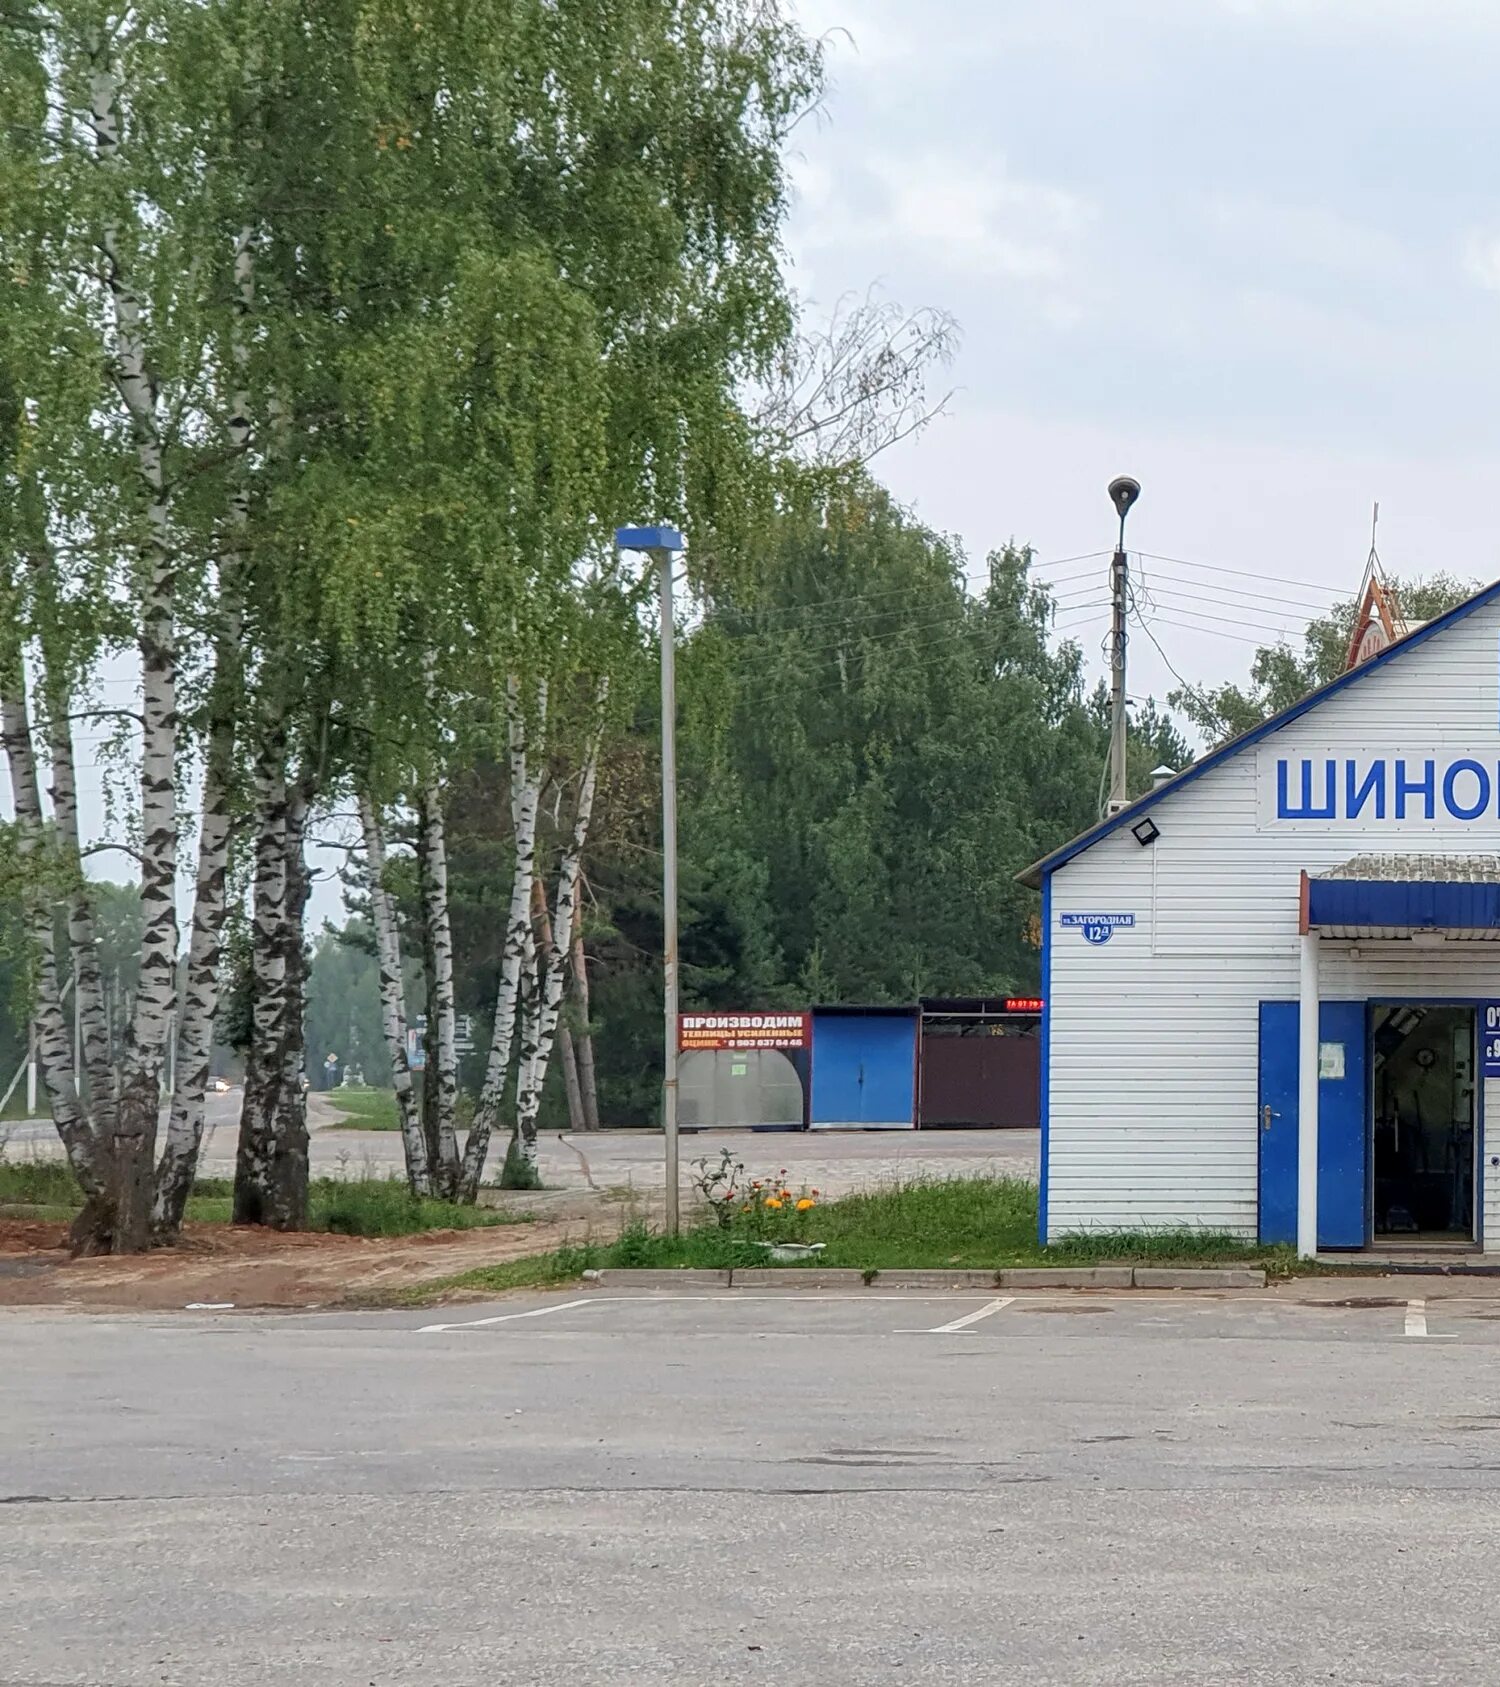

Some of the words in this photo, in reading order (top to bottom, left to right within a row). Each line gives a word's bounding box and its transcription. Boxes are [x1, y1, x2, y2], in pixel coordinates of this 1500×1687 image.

[683, 1016, 803, 1028] ПРОИЗВОДИМ
[683, 1030, 736, 1038] ТЕПЛИЦЫ
[1486, 1046, 1492, 1057] с
